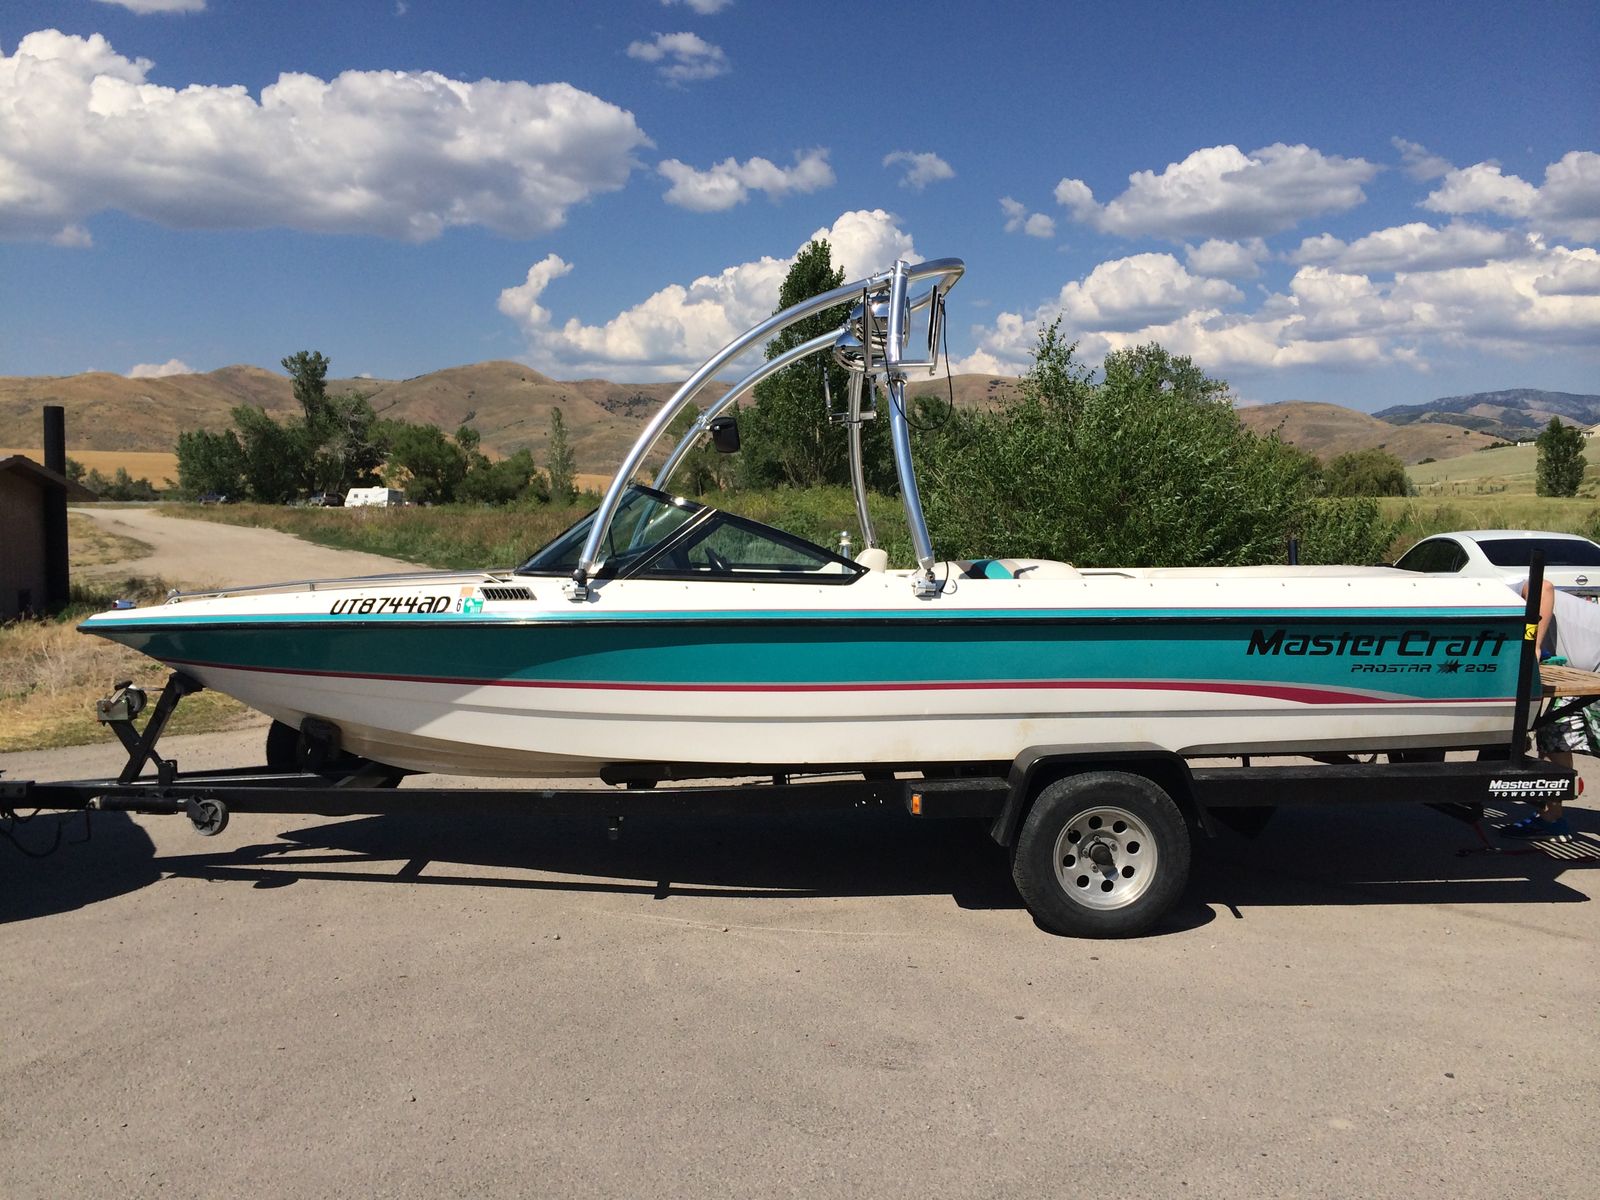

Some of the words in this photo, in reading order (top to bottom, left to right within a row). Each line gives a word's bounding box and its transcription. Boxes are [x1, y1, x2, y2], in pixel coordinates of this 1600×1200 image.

[1246, 629, 1509, 656] MasterCraft
[1351, 663, 1432, 673] PROSTAR
[1465, 663, 1498, 673] 205
[1489, 779, 1569, 789] MasterCraft
